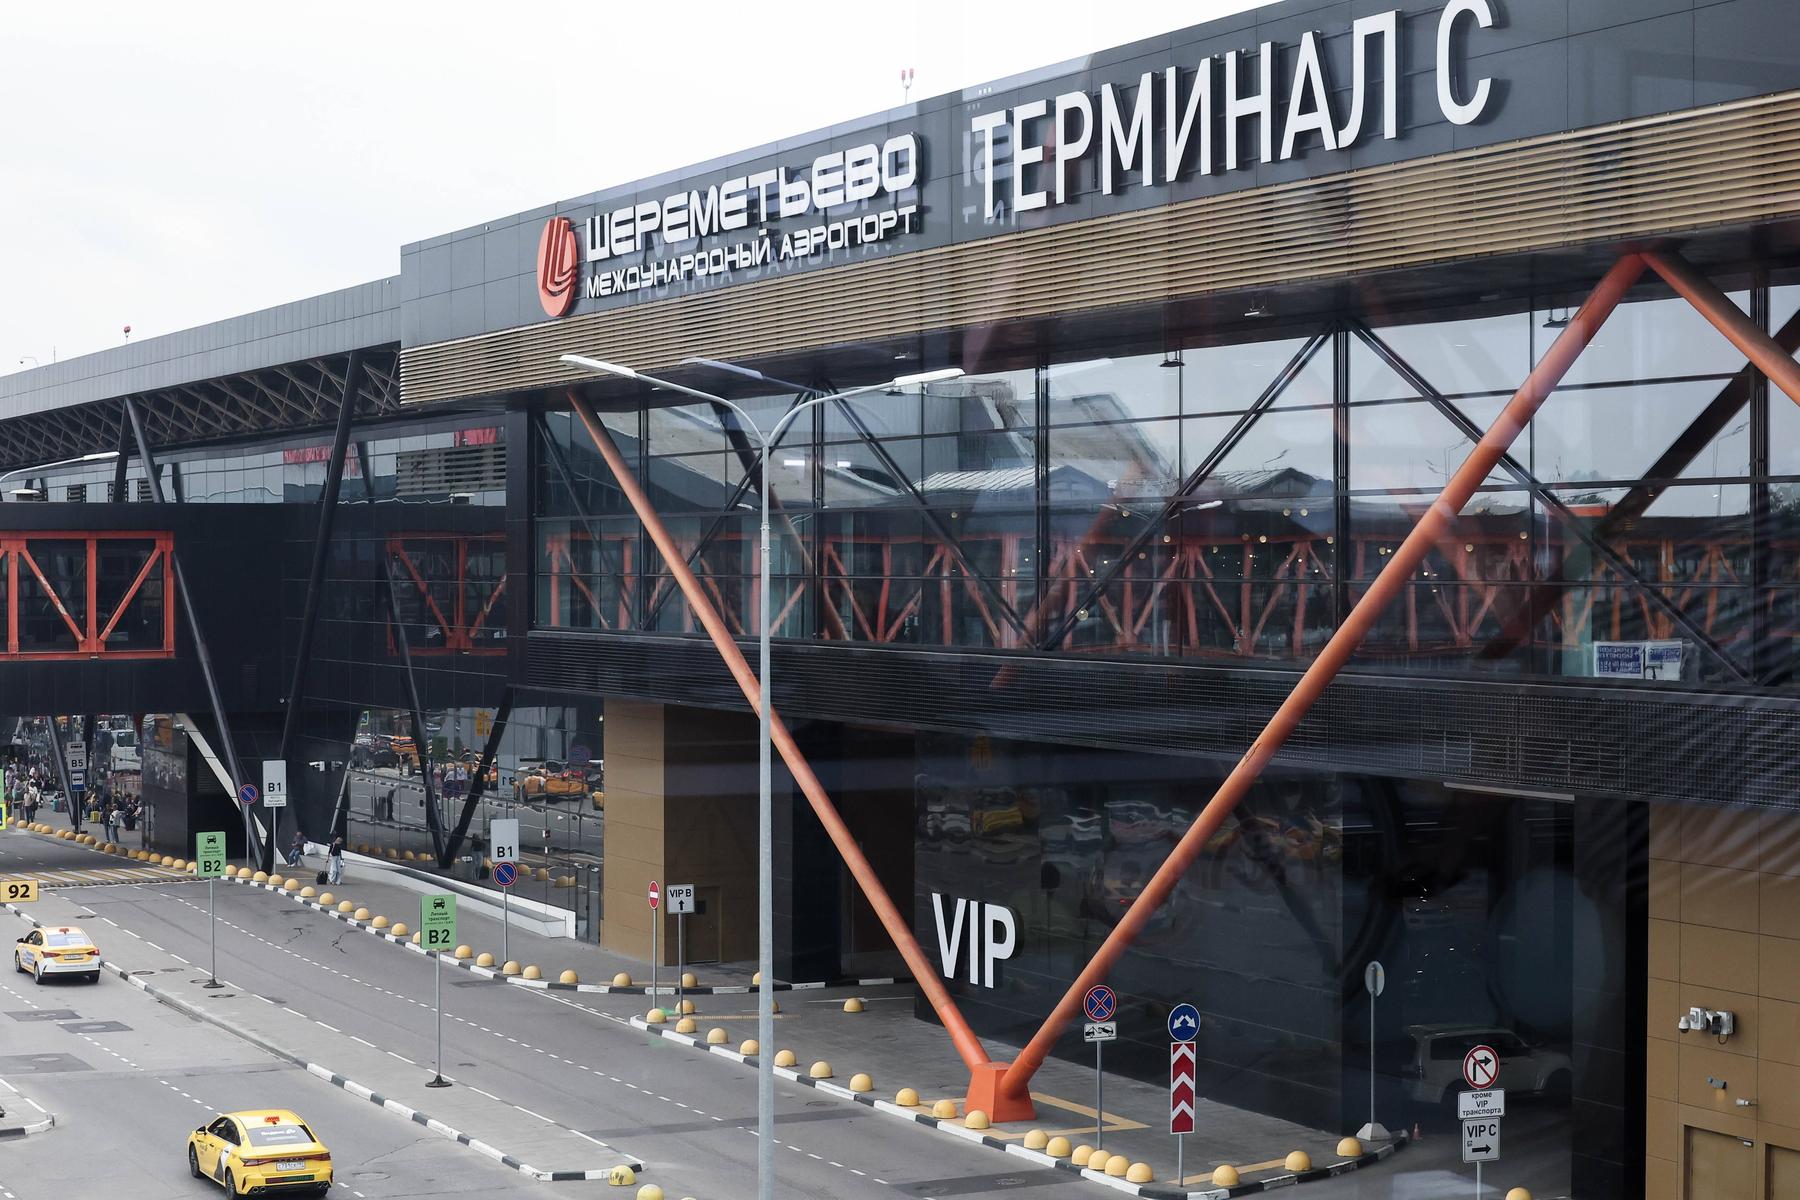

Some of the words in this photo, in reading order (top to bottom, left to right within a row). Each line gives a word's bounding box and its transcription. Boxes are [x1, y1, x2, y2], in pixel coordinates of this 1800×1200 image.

[972, 9, 1397, 218] ТЕРМИНАЛ
[586, 134, 917, 262] ШЕРЕМЕТЬЕВО
[586, 229, 771, 299] МЕЖДУНАРОДНЫЙ
[780, 205, 917, 260] АЭРОПОРТ
[71, 759, 84, 768] B5
[268, 782, 281, 792] B1
[497, 846, 513, 858] B1
[203, 860, 221, 872] B2
[8, 884, 30, 899] 92
[670, 888, 684, 898] VIP
[685, 888, 692, 898] B
[428, 929, 450, 944] B2
[932, 892, 1016, 989] VIP
[1471, 1092, 1493, 1100] кроме
[1476, 1100, 1488, 1108] VIP
[1462, 1107, 1502, 1116] транспорта
[1467, 1124, 1486, 1138] VIP
[1488, 1124, 1497, 1137] C
